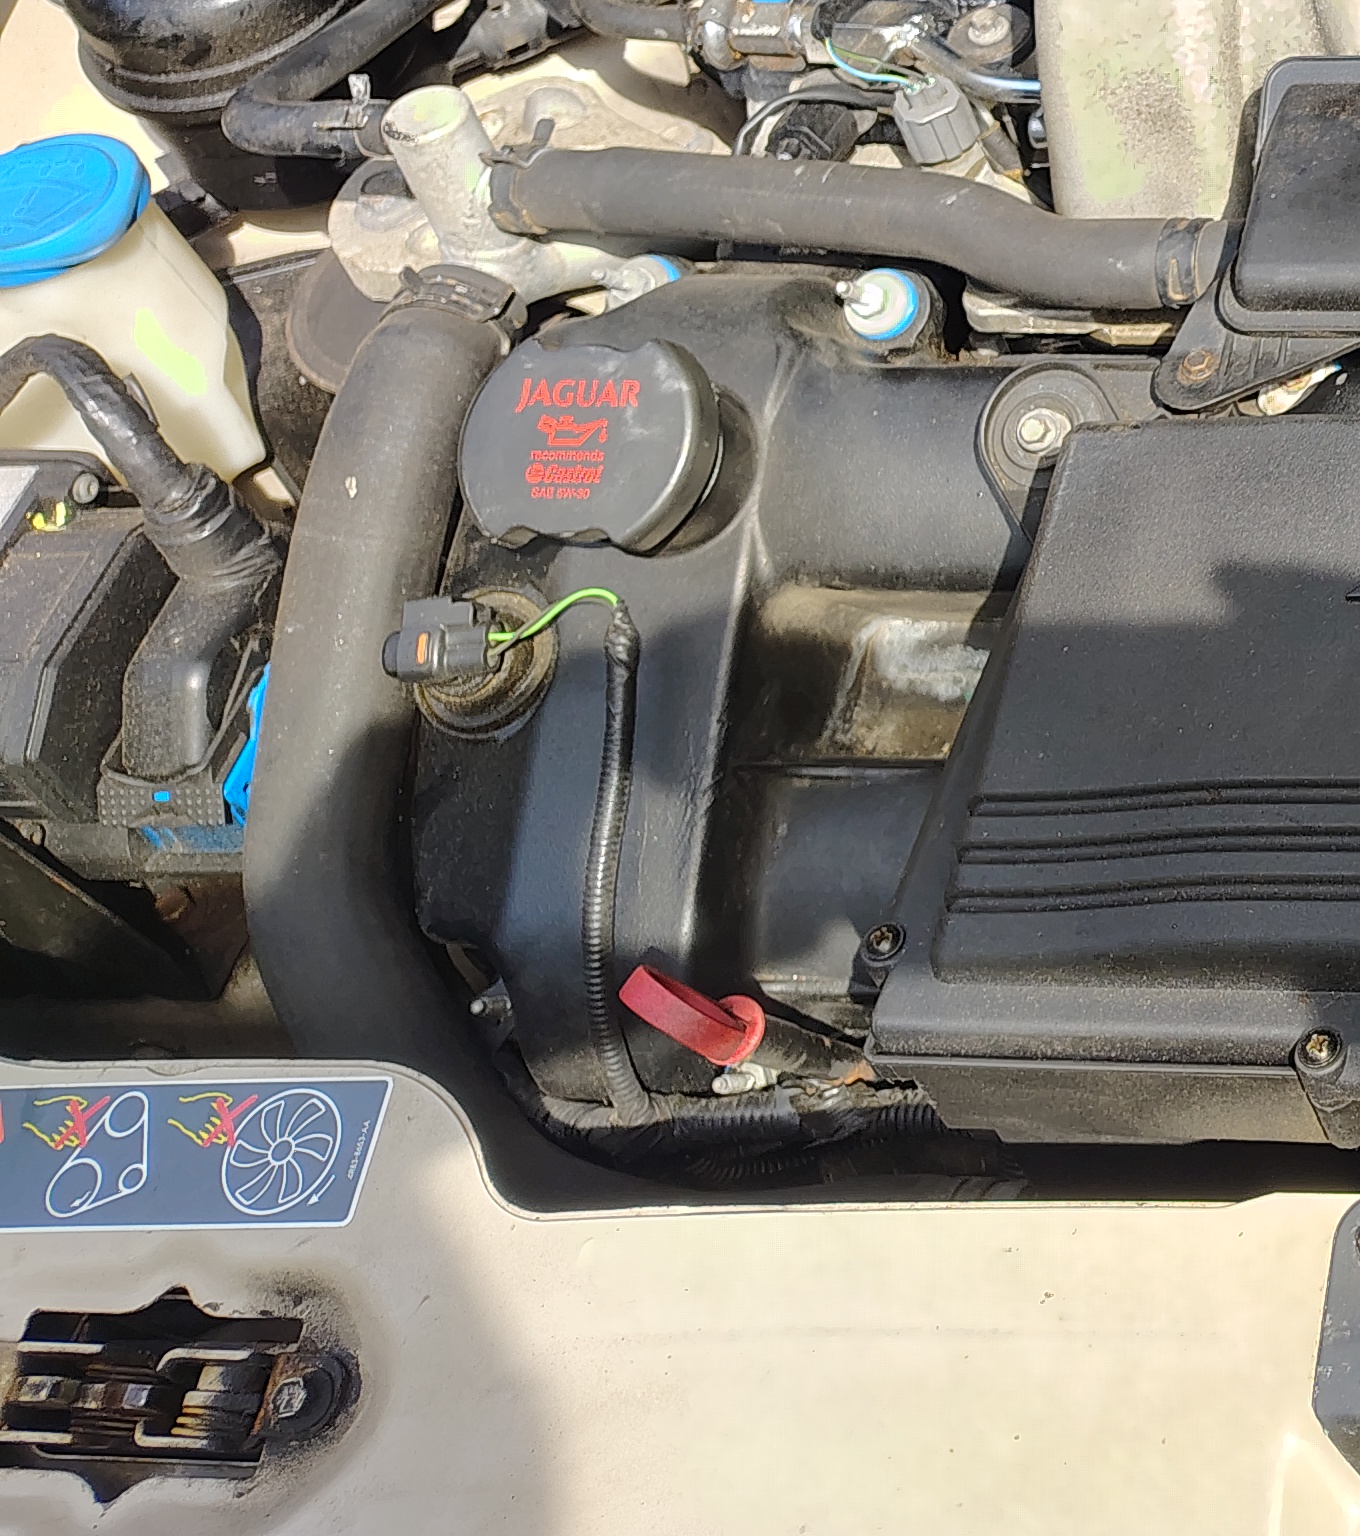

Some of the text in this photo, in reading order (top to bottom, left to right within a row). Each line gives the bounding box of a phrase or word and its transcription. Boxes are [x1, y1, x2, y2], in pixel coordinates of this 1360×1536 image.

[514, 378, 641, 413] JAGUAR
[530, 449, 604, 462] recommends
[543, 464, 604, 484] Castrol
[531, 486, 554, 499] SAE
